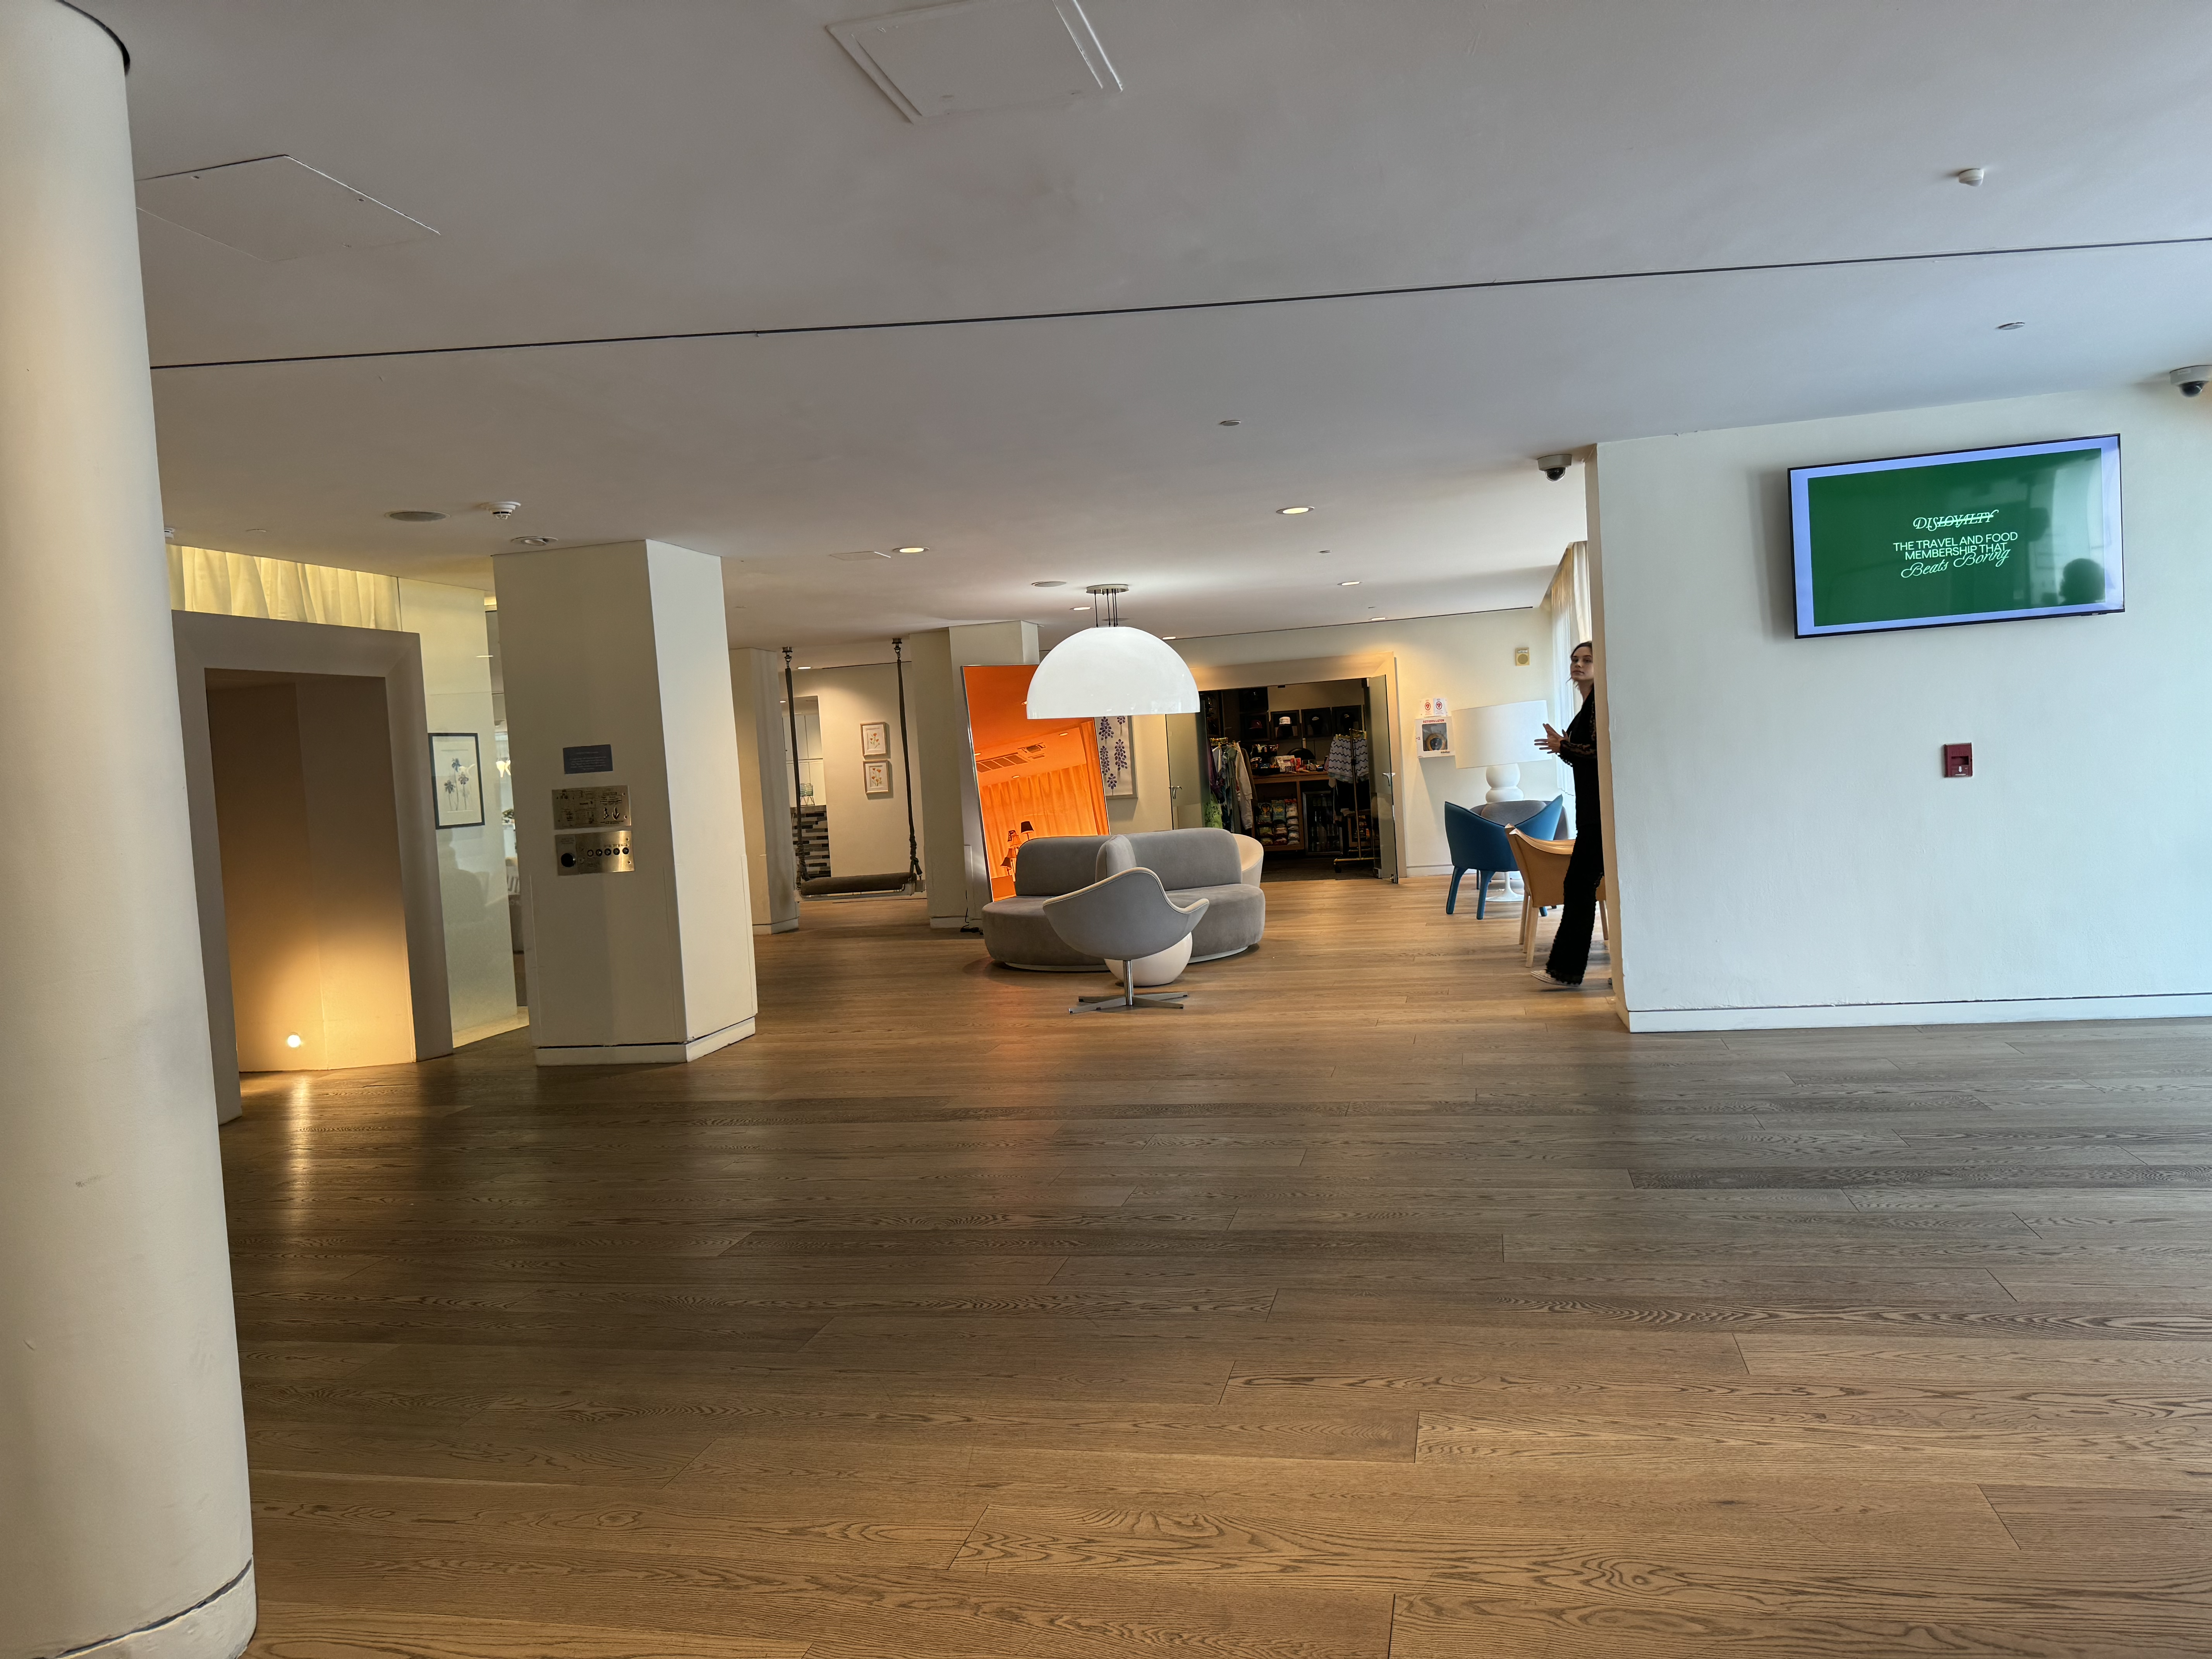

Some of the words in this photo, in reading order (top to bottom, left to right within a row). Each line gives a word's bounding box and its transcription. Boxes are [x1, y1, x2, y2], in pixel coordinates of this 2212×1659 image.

[1893, 541, 1914, 551] THE
[1916, 538, 1958, 549] TRAVEL
[1959, 535, 1983, 546] AND
[1986, 532, 2018, 543] FOOD
[1905, 545, 1977, 560] MEMBERSHIP
[1978, 542, 2008, 553] THAT
[1901, 559, 1949, 578] Beats
[1953, 549, 2011, 567] Boring
